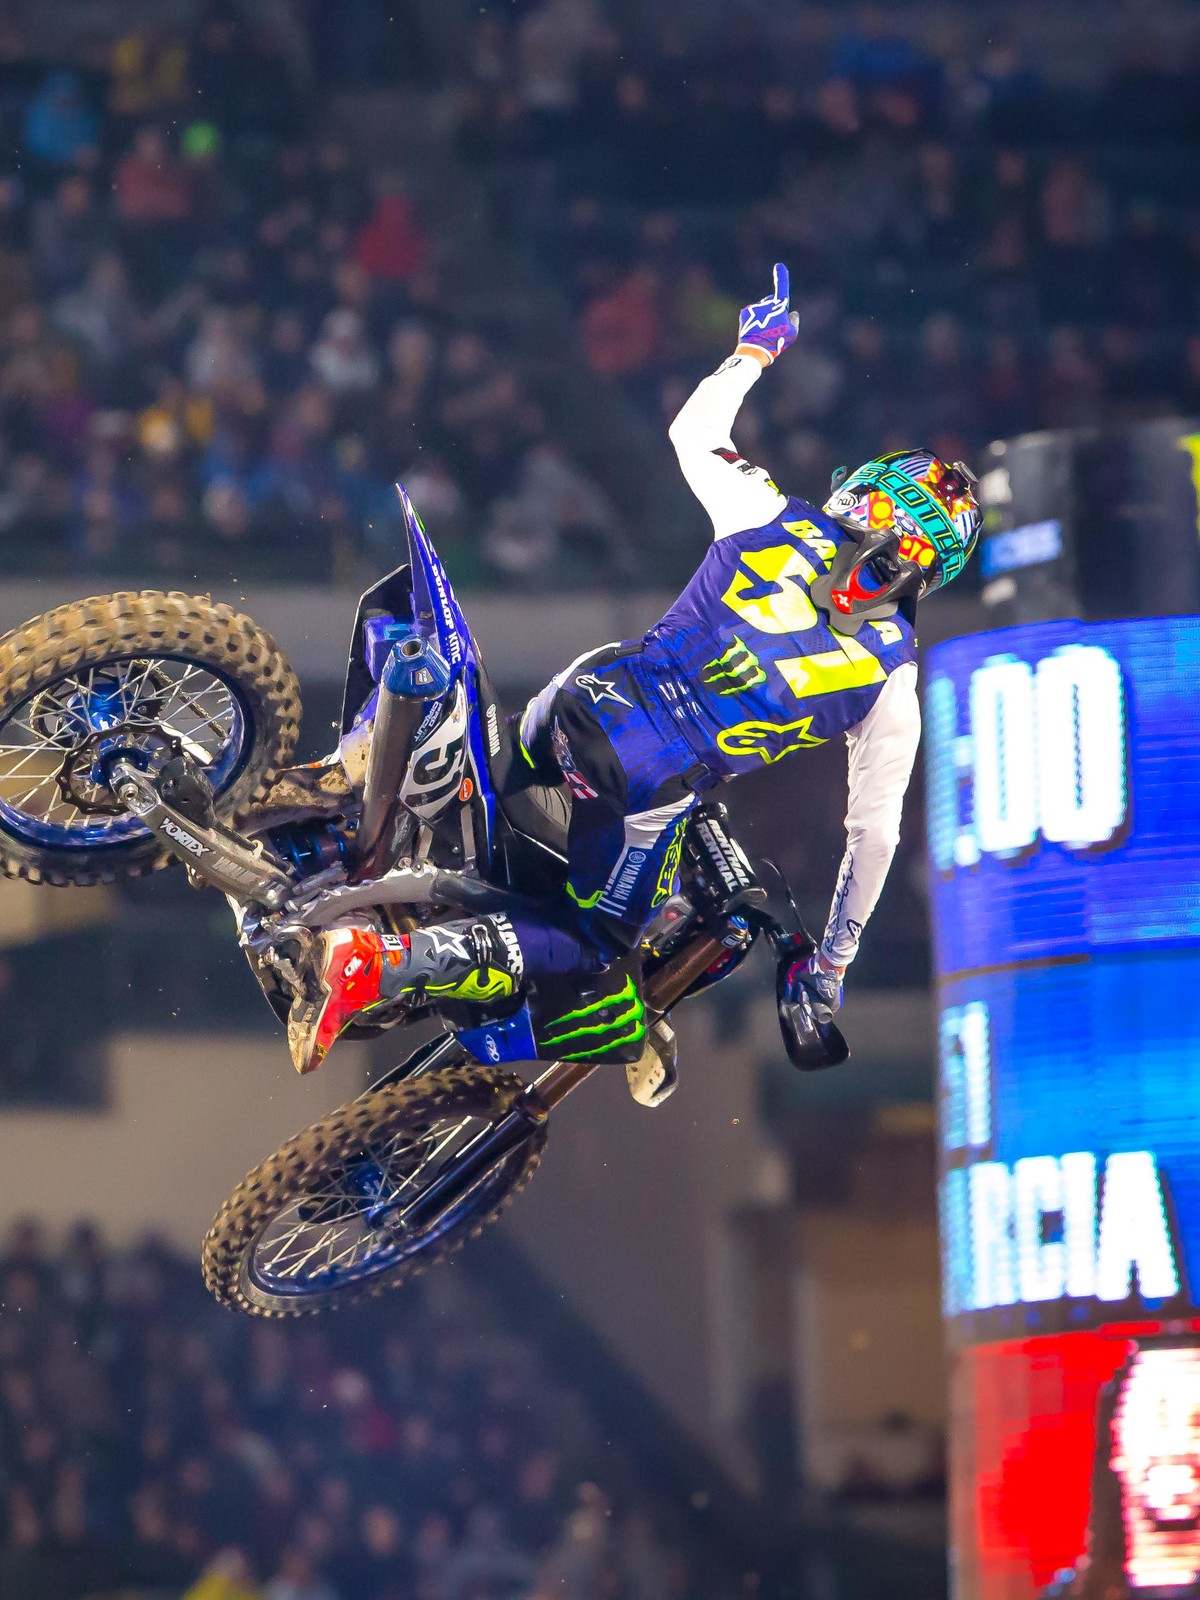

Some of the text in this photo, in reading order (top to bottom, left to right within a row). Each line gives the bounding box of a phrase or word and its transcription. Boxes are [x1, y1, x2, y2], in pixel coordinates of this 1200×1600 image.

[431, 563, 455, 630] DUNLOP
[447, 628, 462, 664] KMC
[721, 543, 888, 699] 51
[158, 816, 211, 859] VORTEX
[696, 822, 739, 893] RENTHAL
[706, 819, 751, 887] RENTHAL
[611, 863, 643, 902] YAMAHA
[940, 1150, 1181, 1316] RCIA
